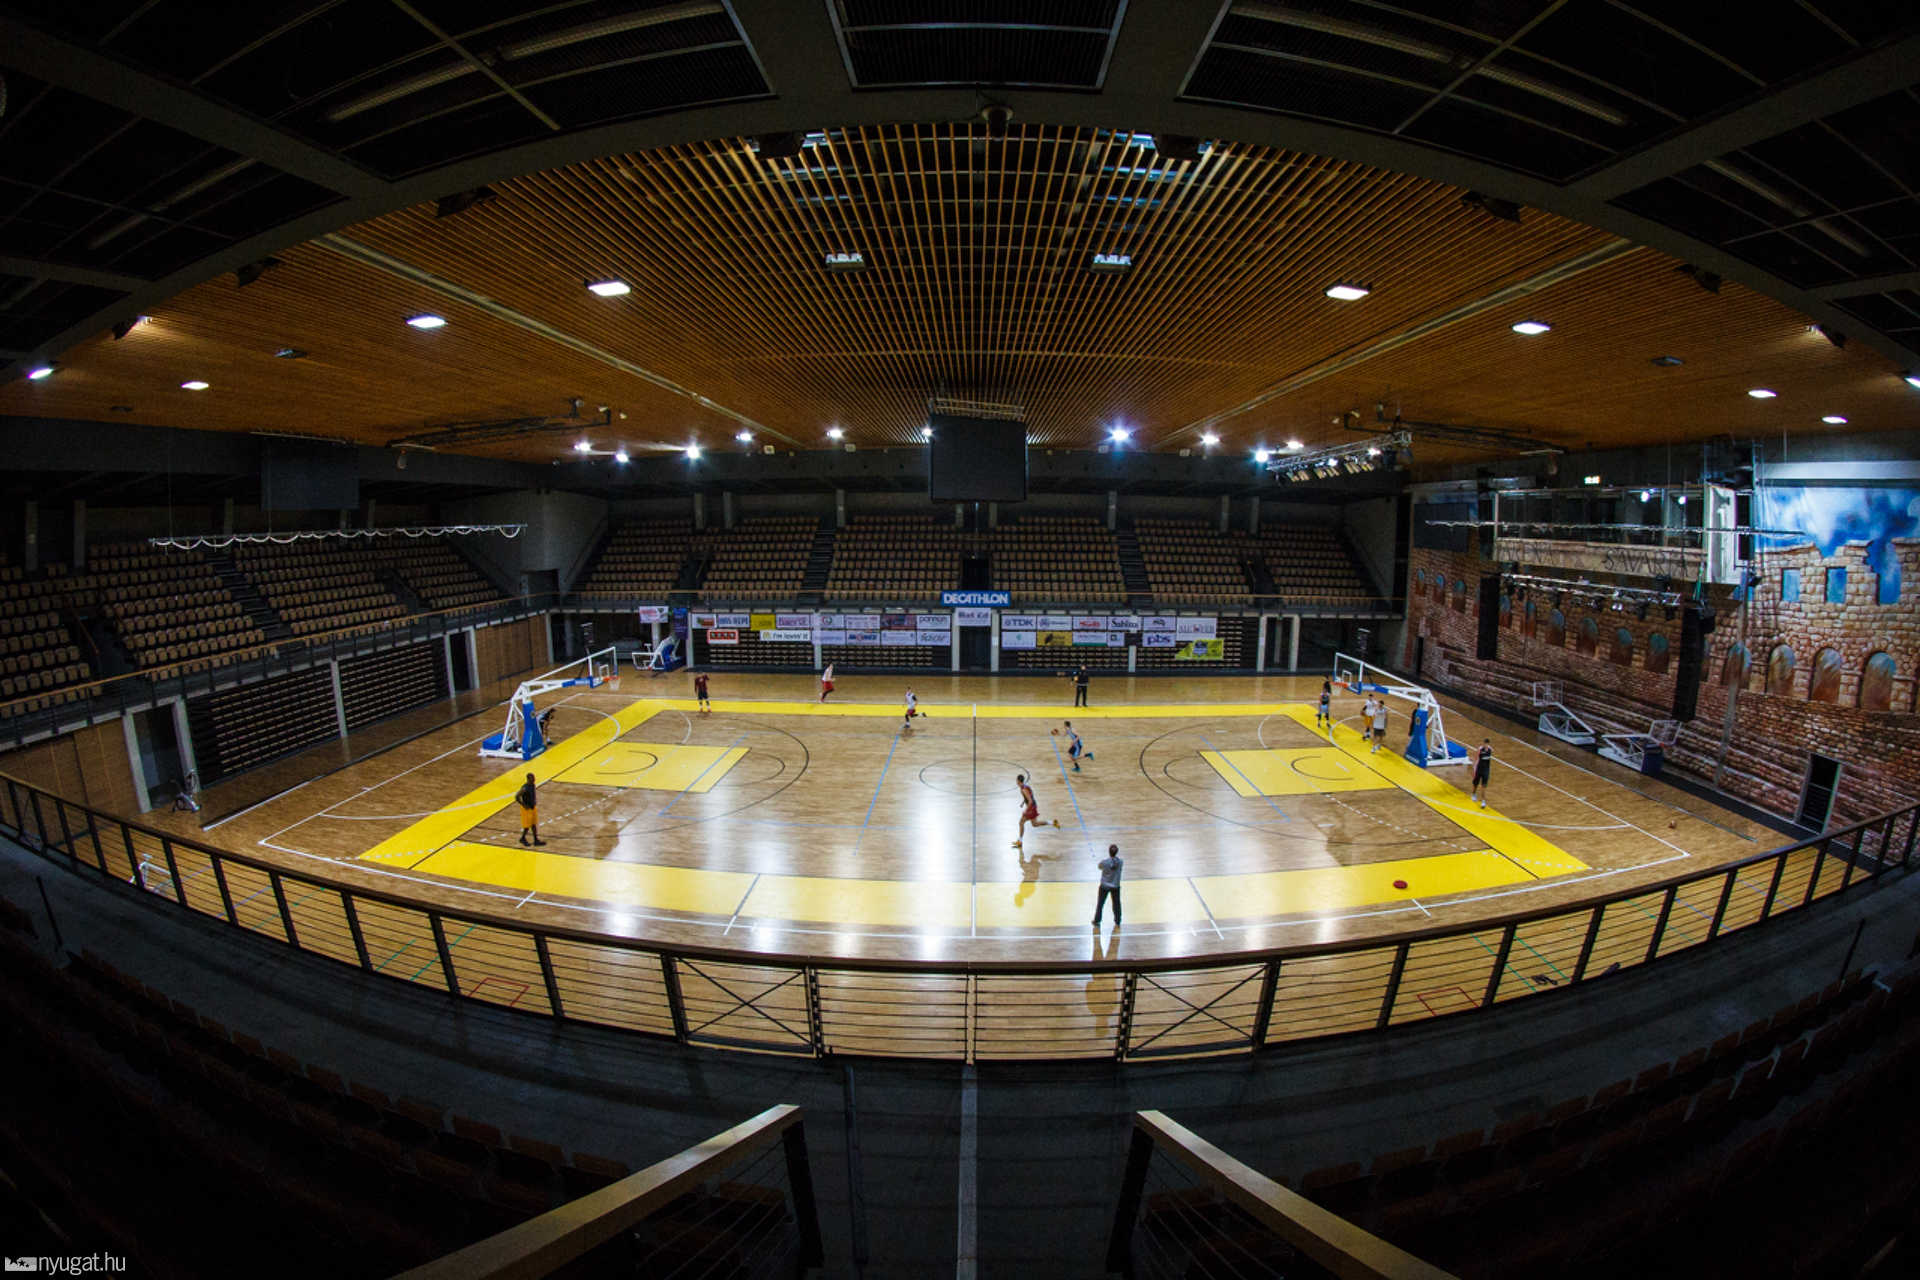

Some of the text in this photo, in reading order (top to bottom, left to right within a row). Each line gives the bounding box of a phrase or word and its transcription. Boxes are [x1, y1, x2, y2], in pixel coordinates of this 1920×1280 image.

[943, 592, 1009, 604] DECATHLON
[1011, 619, 1034, 627] TDK
[1146, 633, 1172, 646] pbs
